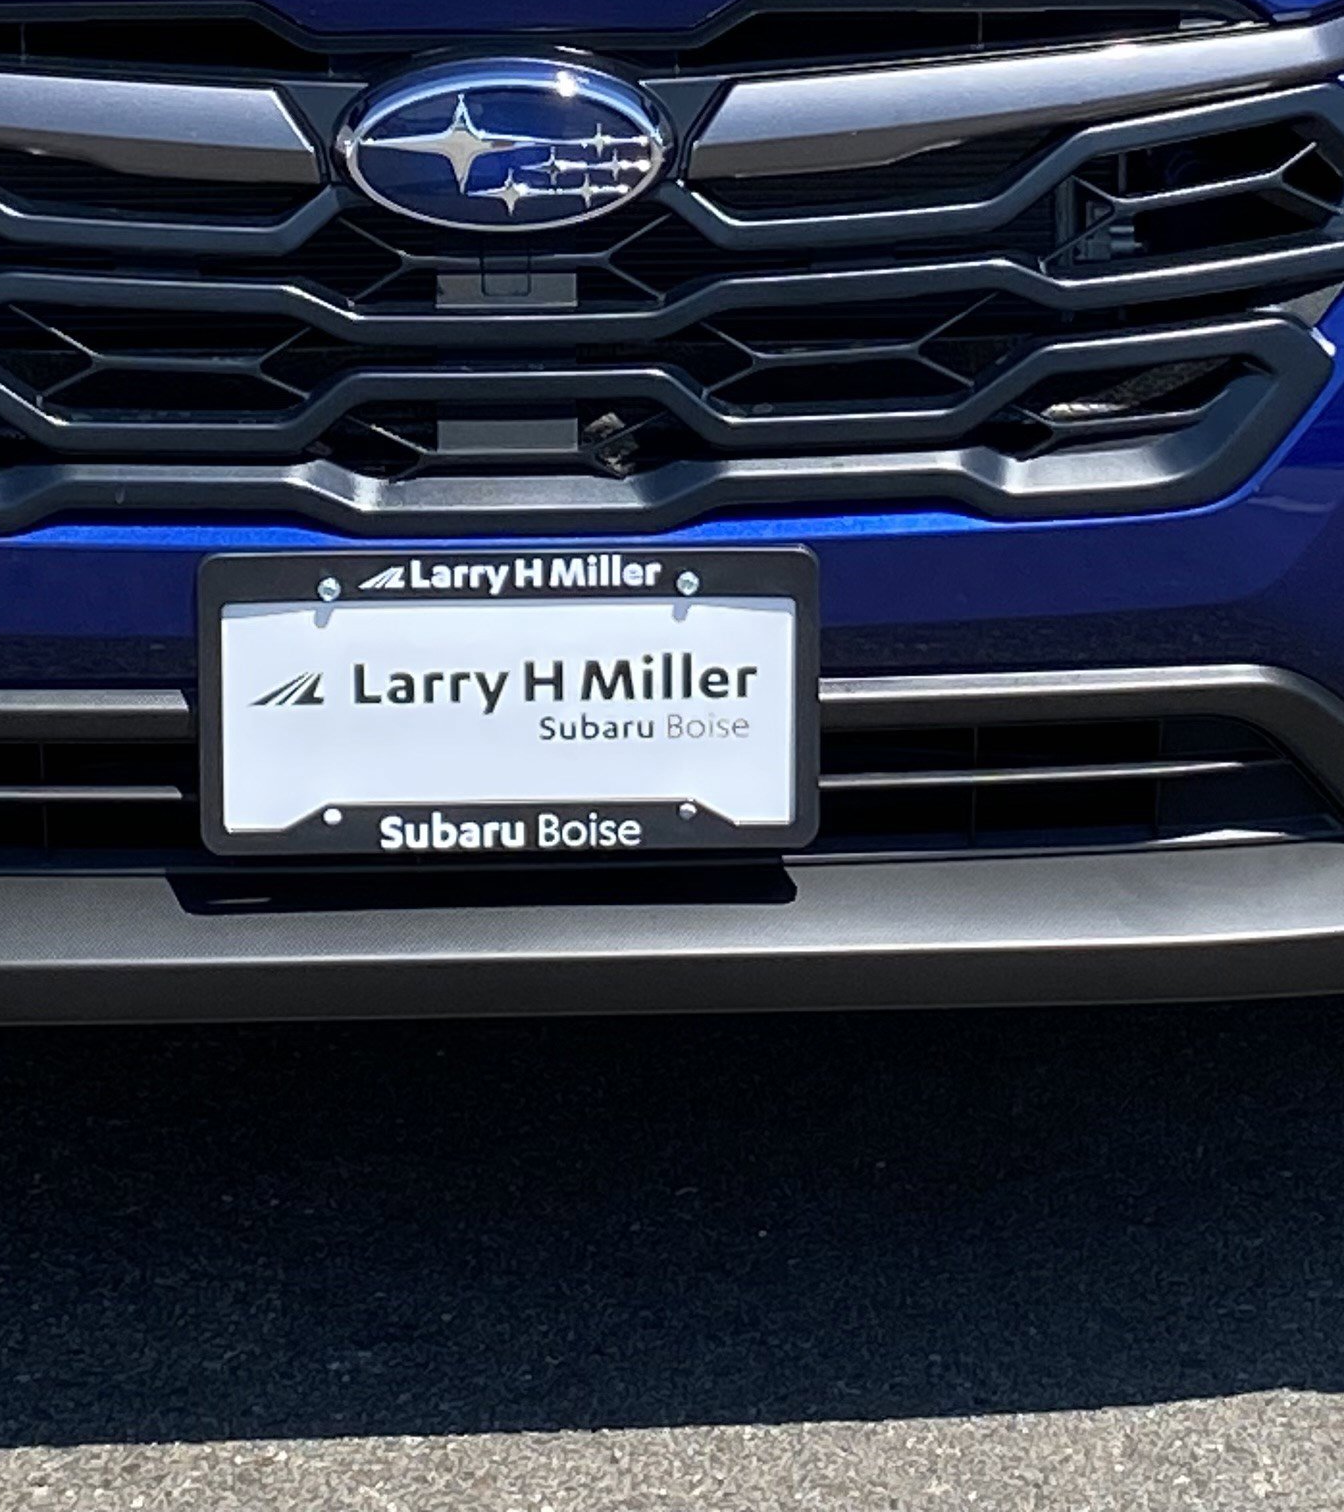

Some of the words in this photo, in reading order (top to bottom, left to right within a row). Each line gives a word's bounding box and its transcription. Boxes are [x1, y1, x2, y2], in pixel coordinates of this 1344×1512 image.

[410, 559, 509, 596] Larry
[514, 558, 543, 588] H
[549, 554, 662, 588] Miller
[353, 662, 509, 715] Larry
[524, 660, 564, 702] H
[580, 652, 758, 702] Miller
[539, 714, 654, 740] Subaru
[666, 713, 750, 739] Boise
[379, 811, 525, 849] Subaru
[537, 812, 642, 848] Boise
